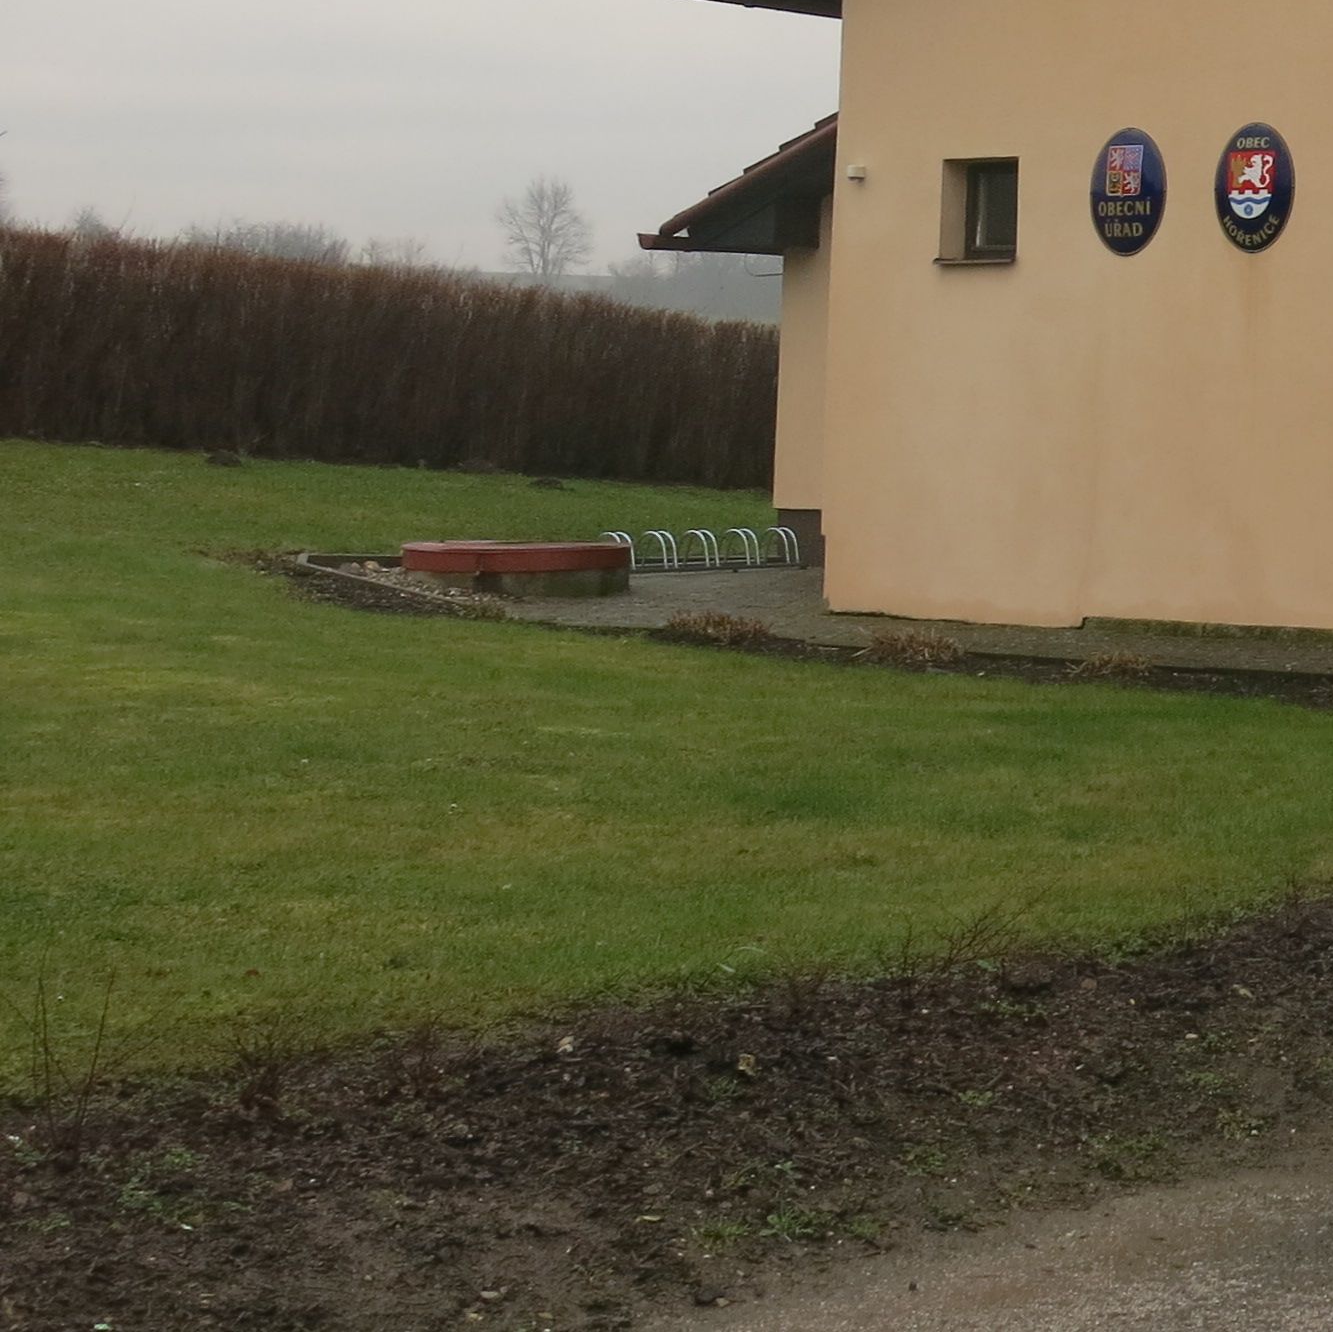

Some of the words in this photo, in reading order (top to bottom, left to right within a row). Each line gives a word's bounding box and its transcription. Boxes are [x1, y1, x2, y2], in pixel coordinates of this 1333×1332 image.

[1236, 136, 1271, 149] OBEC
[1098, 196, 1151, 216] OBECNÍ
[1105, 219, 1143, 237] ÚŘAD
